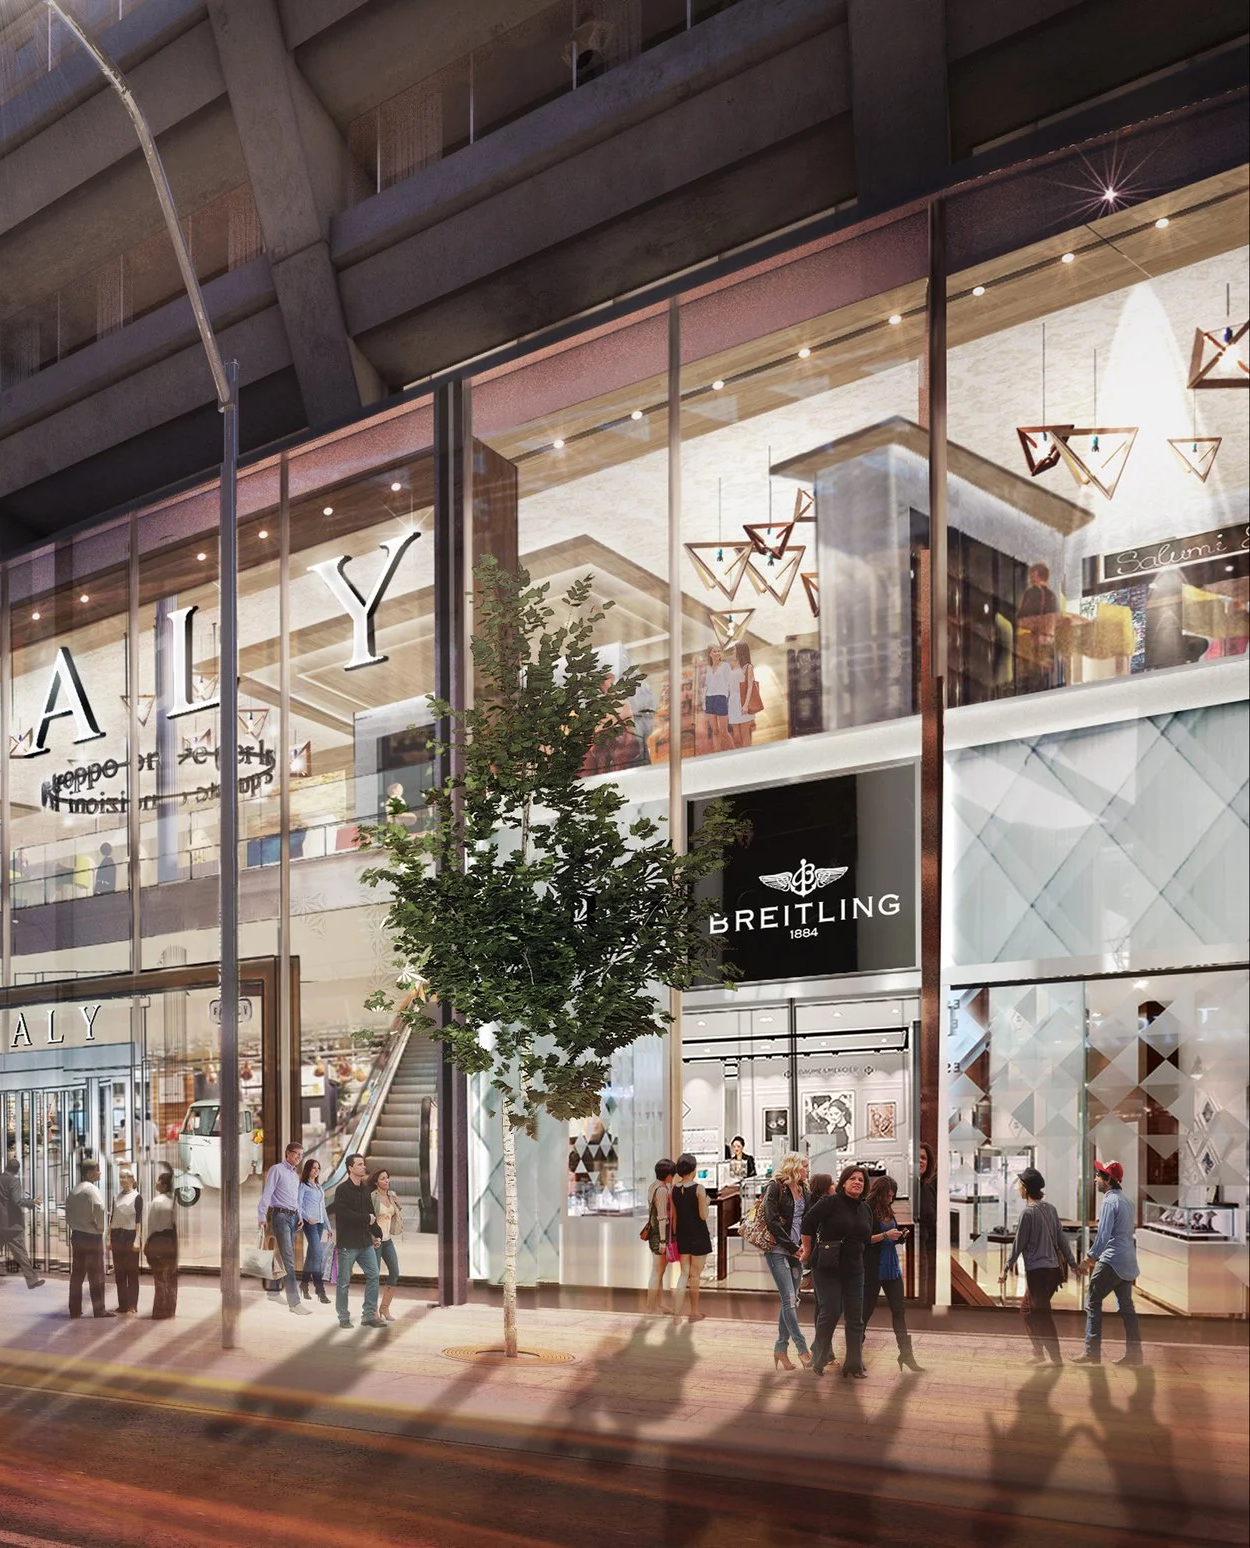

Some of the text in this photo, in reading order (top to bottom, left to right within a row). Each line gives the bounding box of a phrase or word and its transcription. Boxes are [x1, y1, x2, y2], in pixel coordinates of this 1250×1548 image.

[1116, 533, 1227, 575] Salumi
[709, 893, 901, 934] BREITLING
[789, 927, 819, 939] 1884
